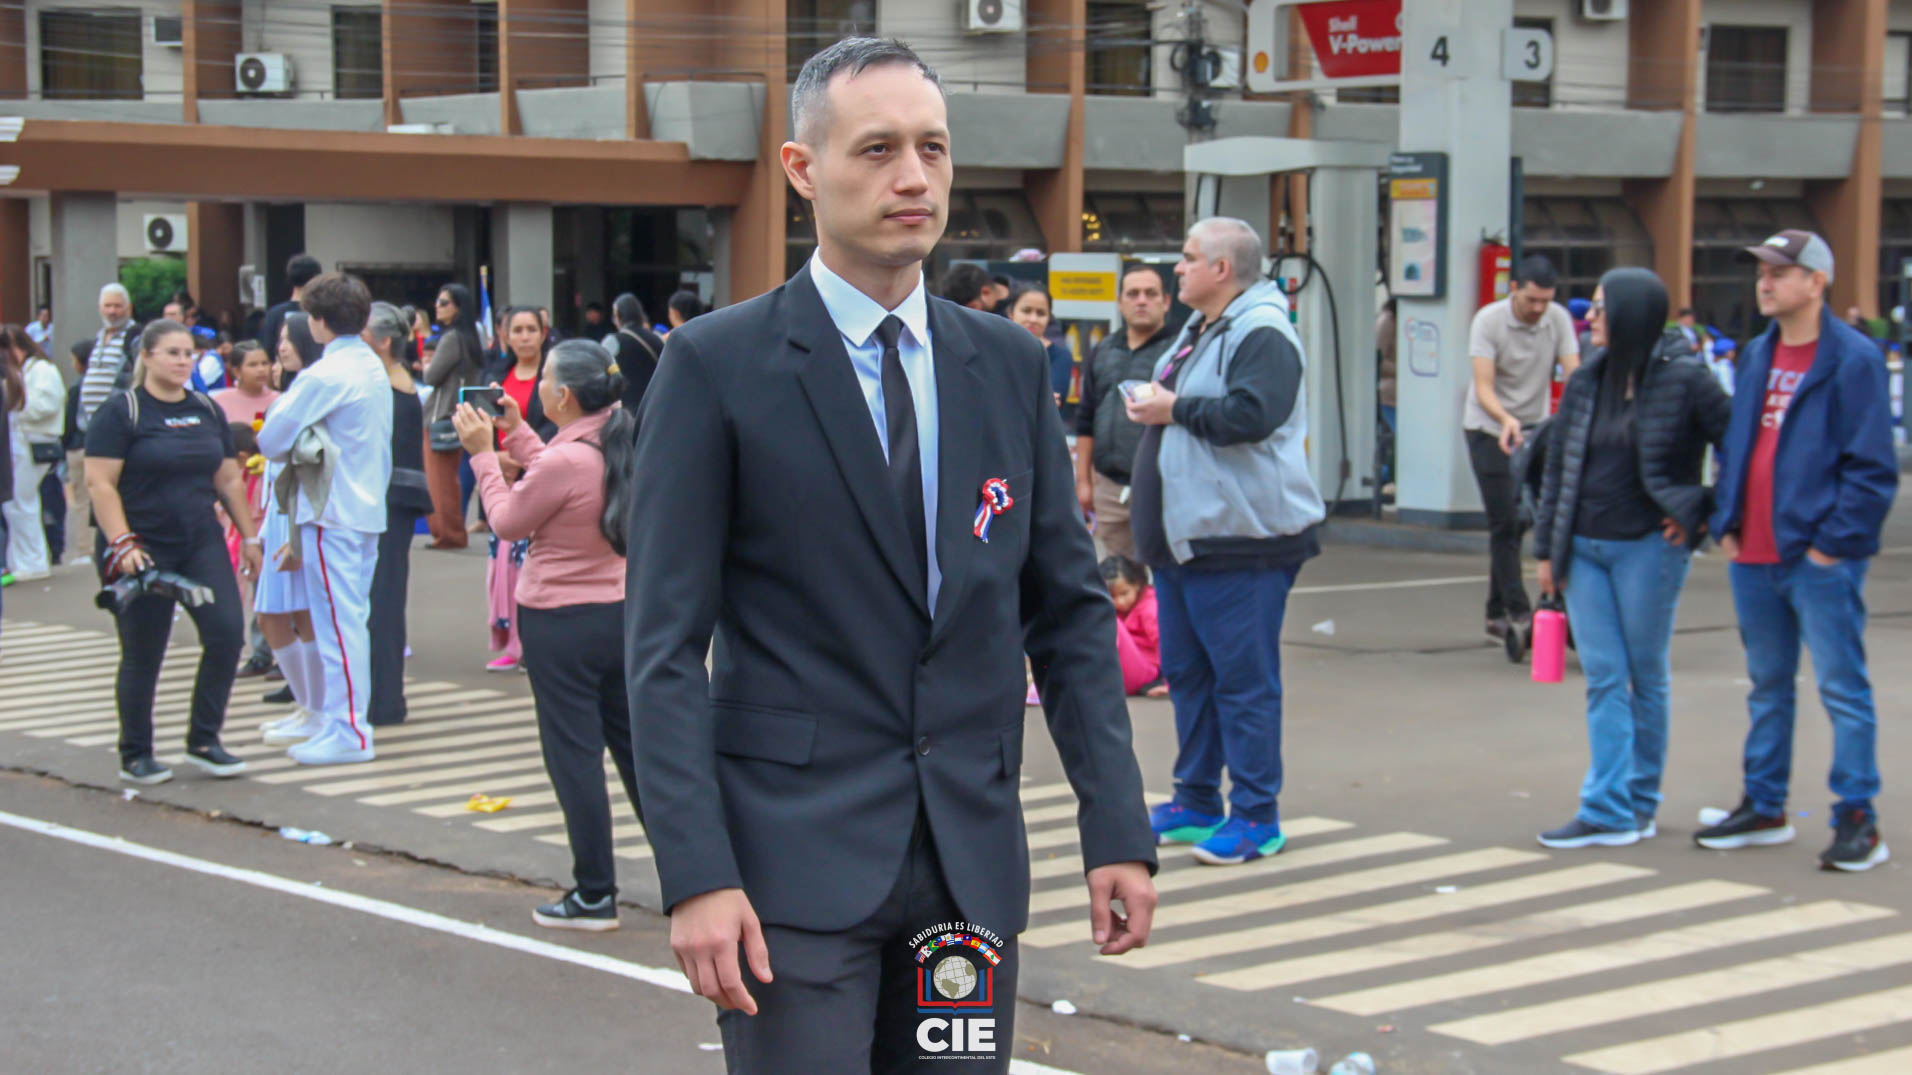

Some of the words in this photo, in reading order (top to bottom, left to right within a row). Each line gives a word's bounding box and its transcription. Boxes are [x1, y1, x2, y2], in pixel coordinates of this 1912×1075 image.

[1328, 15, 1358, 33] Shell
[1430, 36, 1450, 67] 4
[1524, 40, 1541, 69] 3
